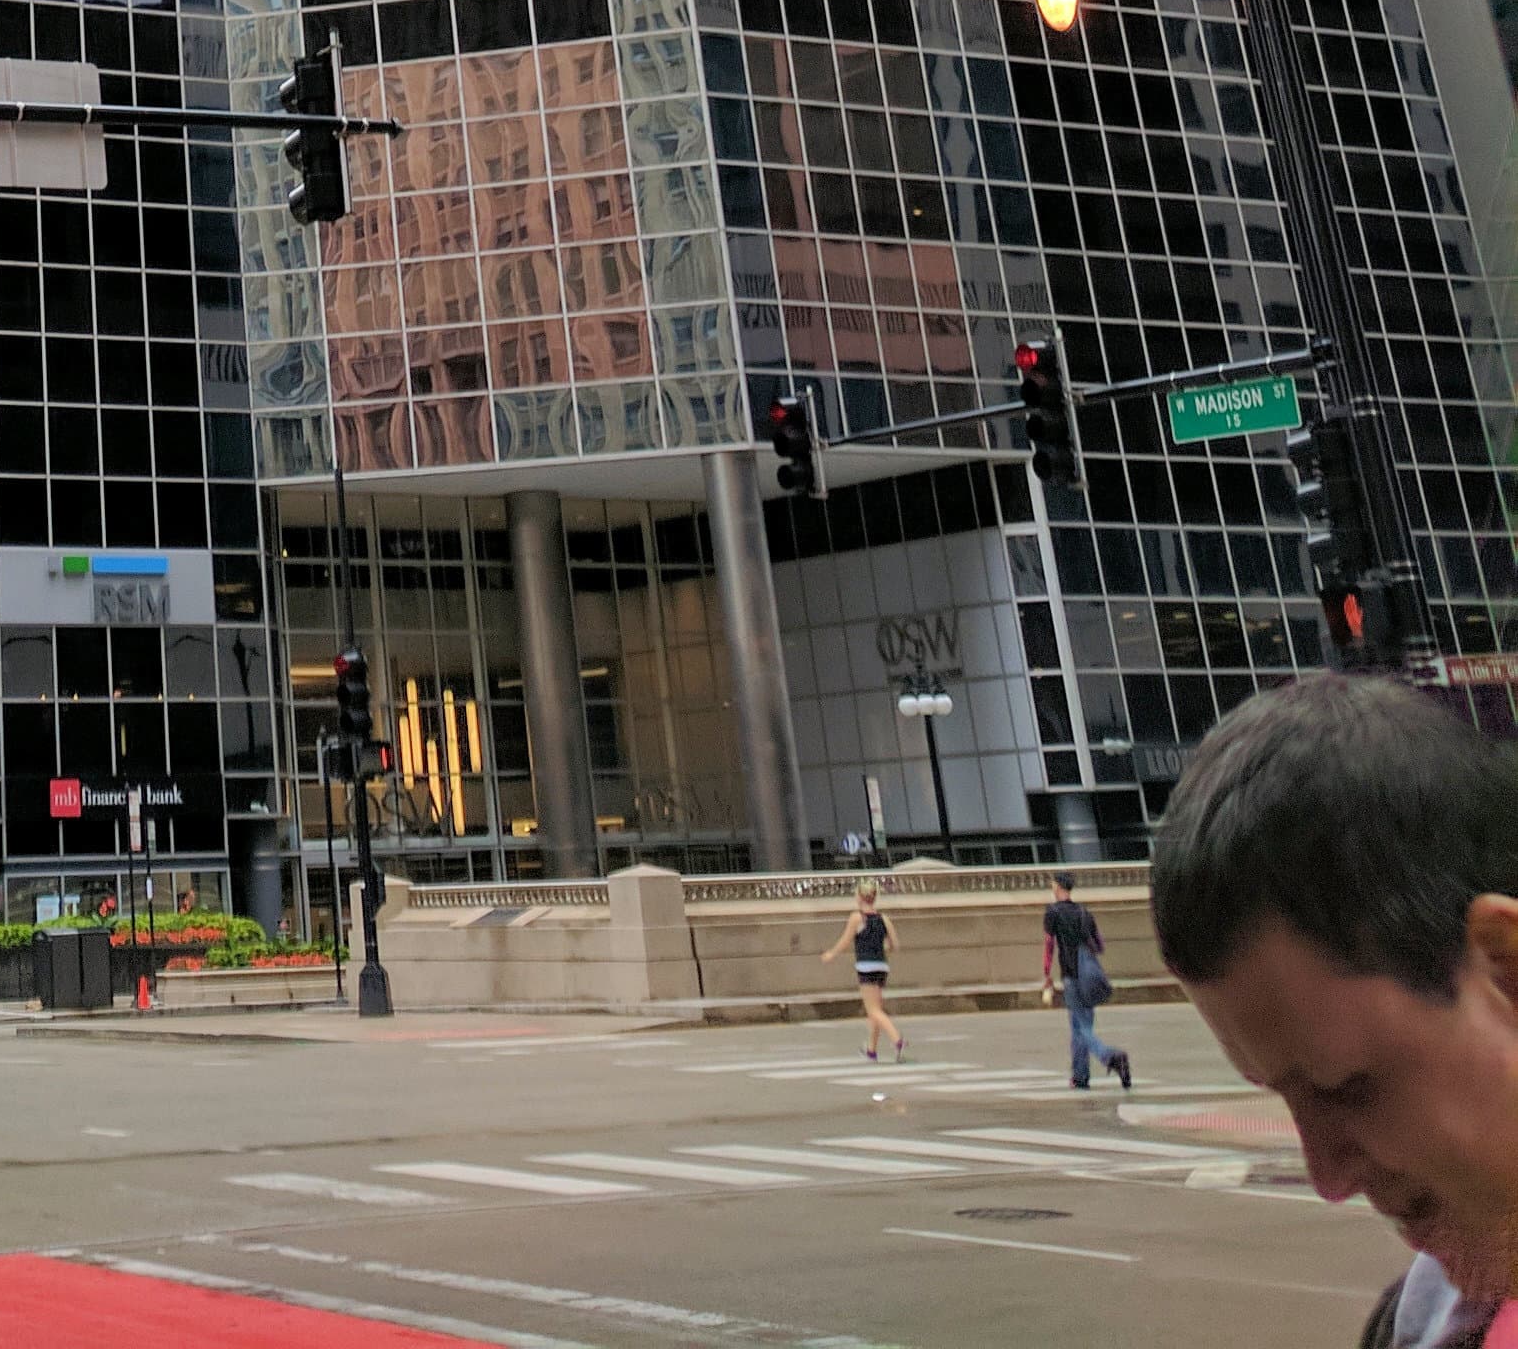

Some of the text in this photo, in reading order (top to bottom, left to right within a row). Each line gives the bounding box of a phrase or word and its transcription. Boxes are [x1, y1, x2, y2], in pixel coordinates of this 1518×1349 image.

[1194, 385, 1263, 416] MADISON
[1272, 382, 1286, 399] ST
[93, 579, 170, 623] RSM
[55, 787, 77, 806] mb
[147, 780, 183, 805] bank
